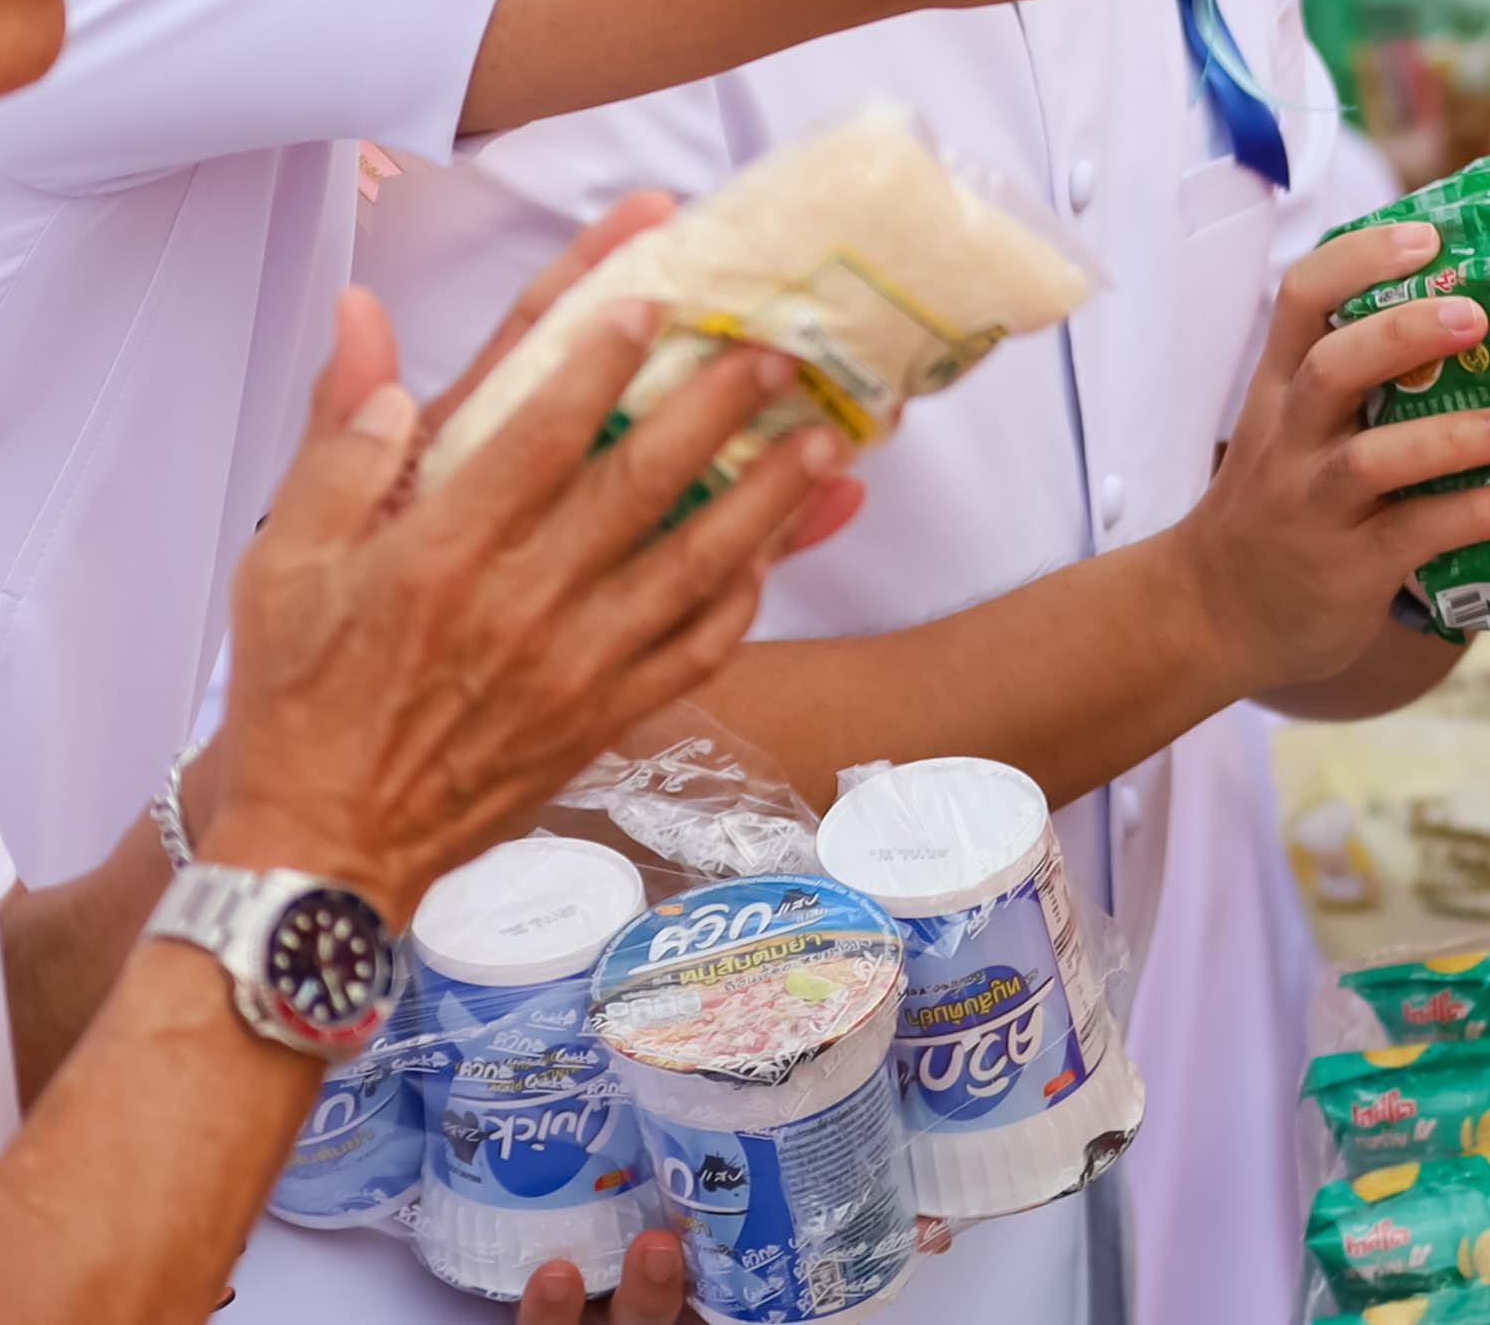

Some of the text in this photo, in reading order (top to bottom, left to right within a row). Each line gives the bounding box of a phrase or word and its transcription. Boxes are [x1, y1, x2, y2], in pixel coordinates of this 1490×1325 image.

[648, 902, 773, 964] ควิก
[918, 1003, 1044, 1098] ควิก
[481, 1100, 622, 1161] Quick
